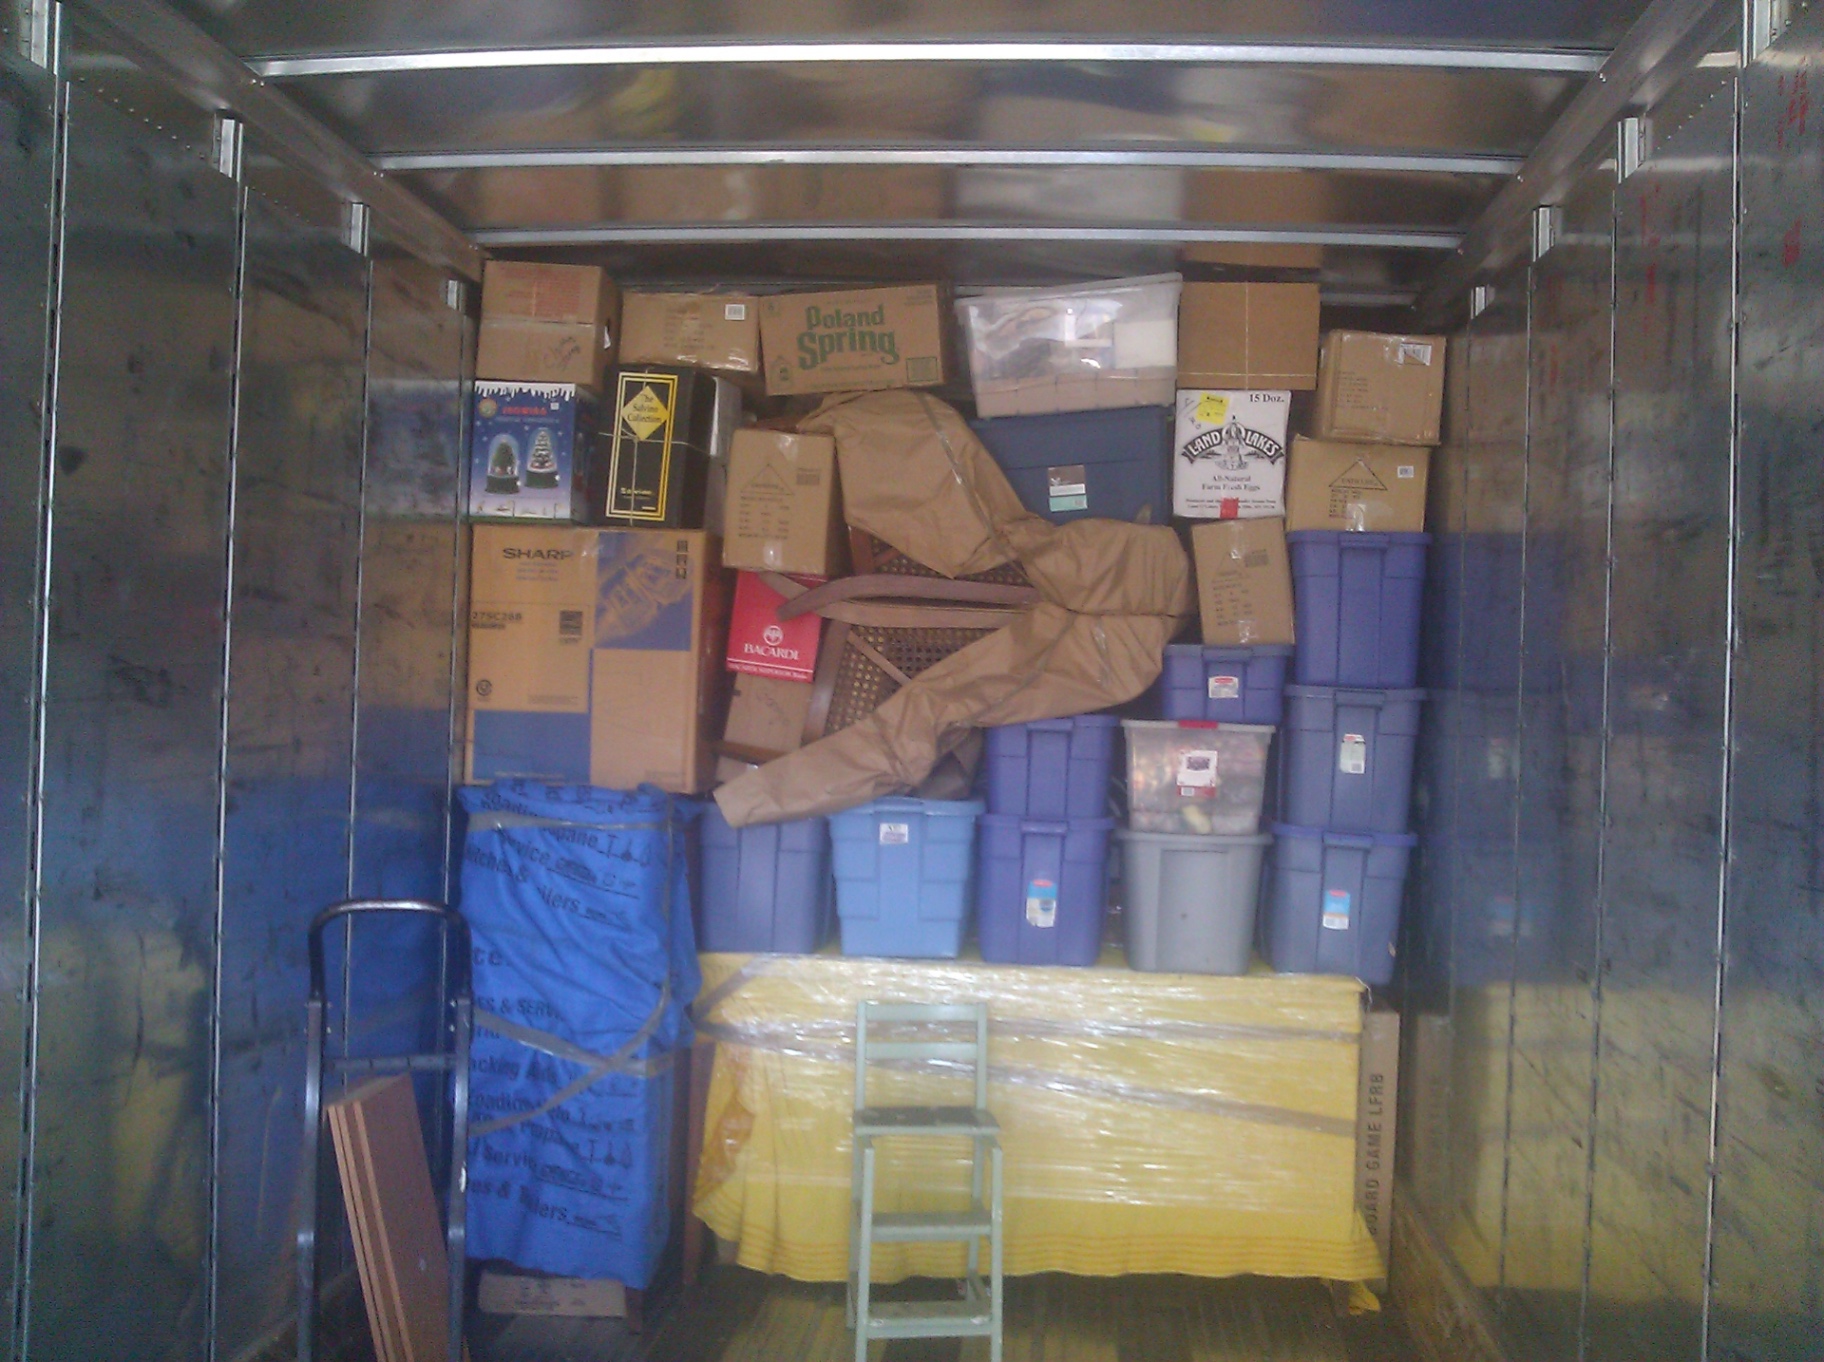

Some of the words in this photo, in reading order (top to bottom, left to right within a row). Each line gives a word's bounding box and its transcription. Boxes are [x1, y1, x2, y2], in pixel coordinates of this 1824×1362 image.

[804, 303, 884, 331] Poland
[796, 327, 900, 370] Spring
[1249, 394, 1260, 403] 15
[1262, 394, 1285, 403] Doz.
[1188, 431, 1222, 456] LAND
[1245, 430, 1280, 457] LAKES
[502, 547, 575, 560] SHARP
[743, 642, 800, 661] BACARDI
[1365, 1122, 1382, 1171] GAME
